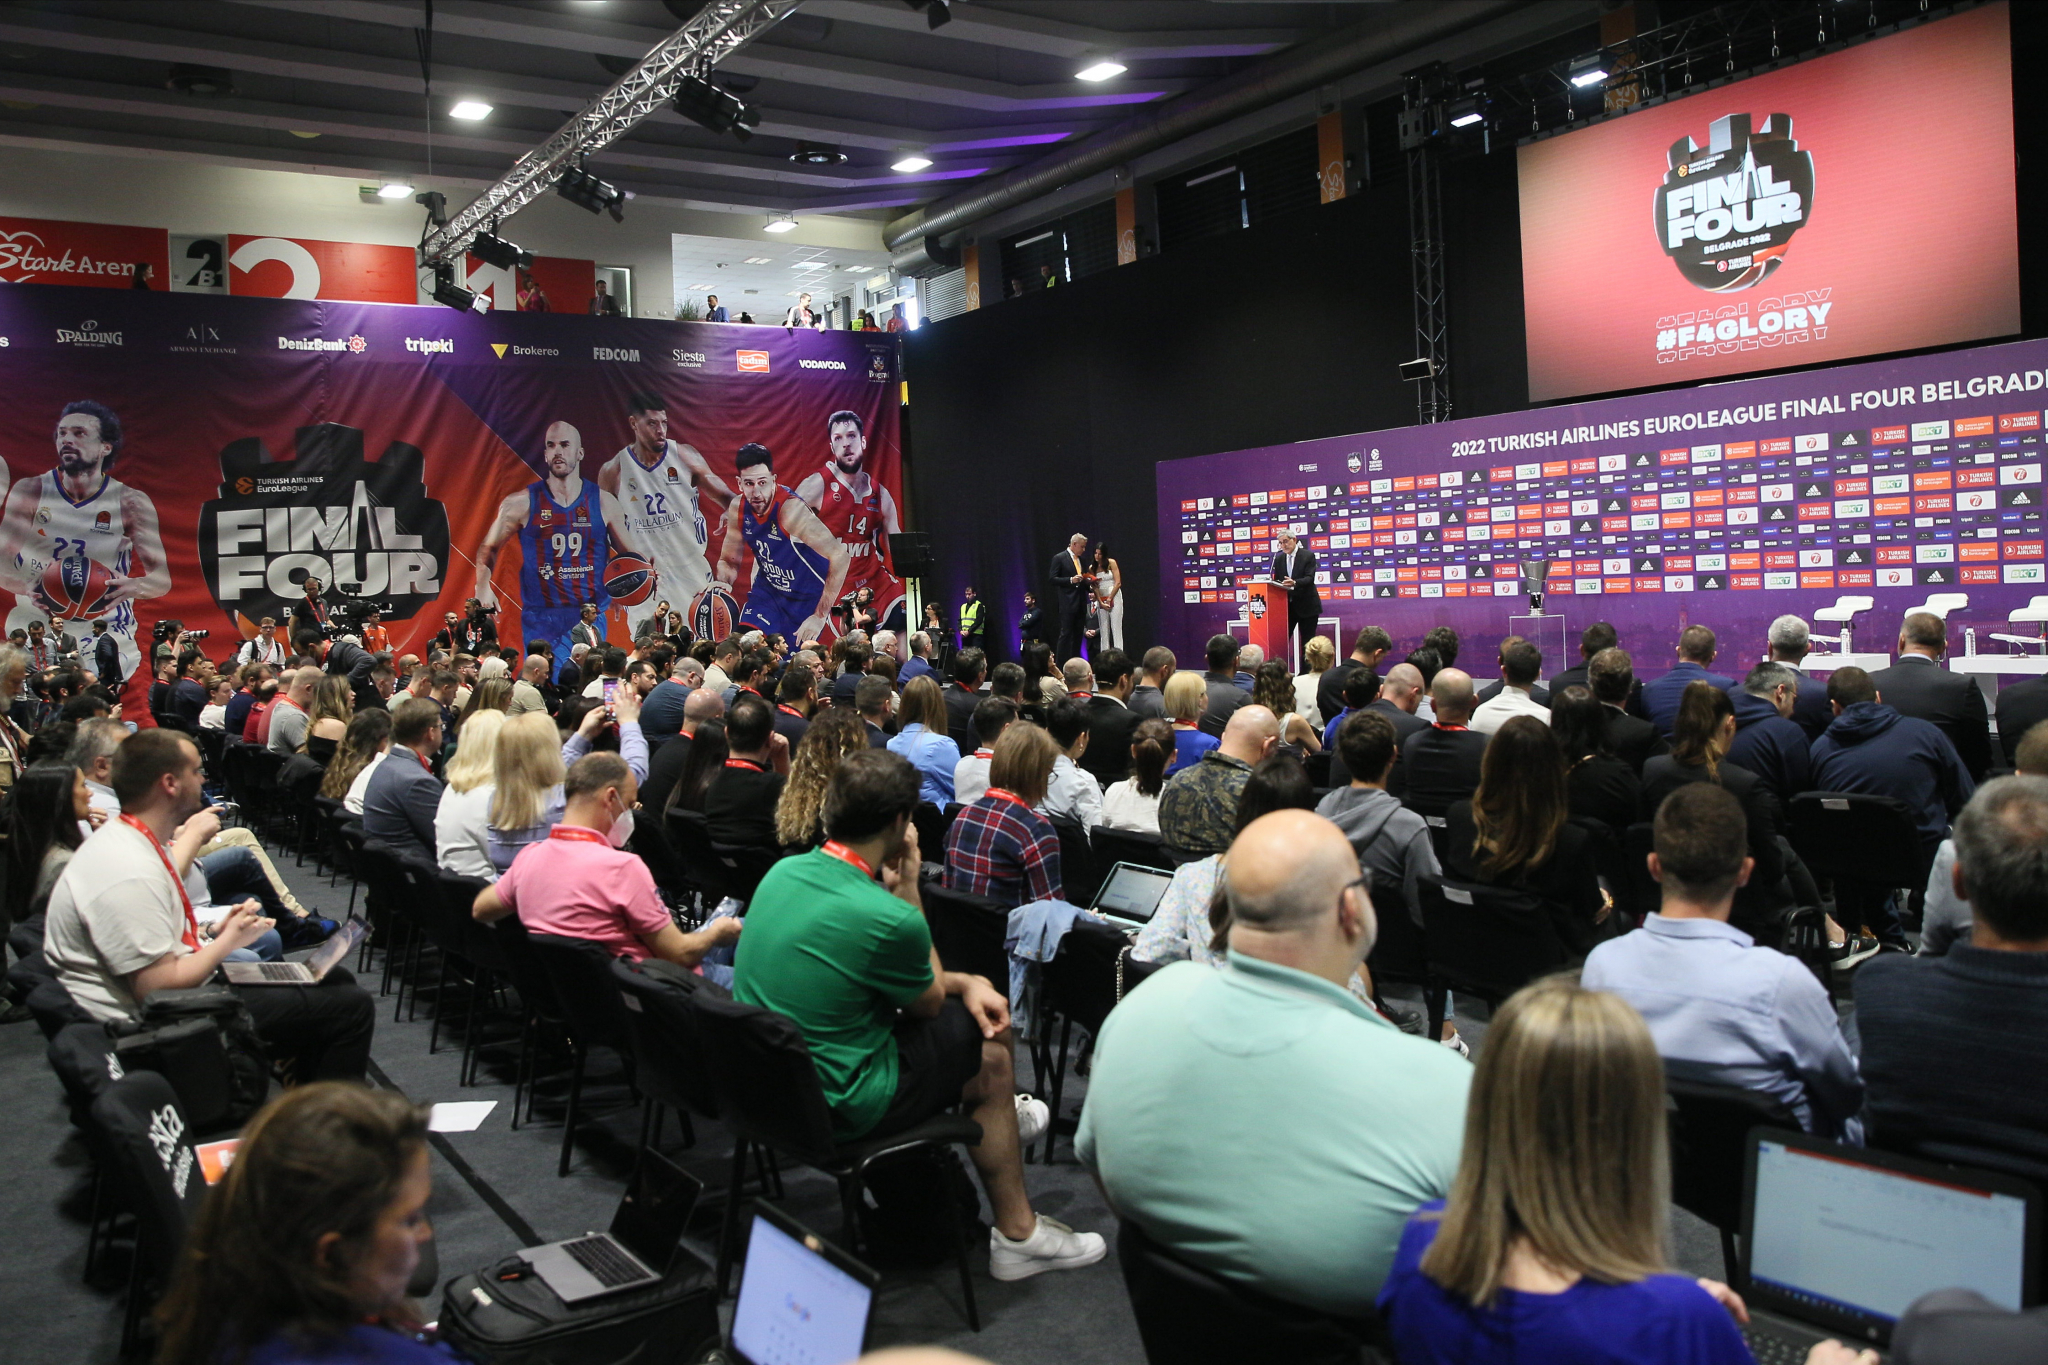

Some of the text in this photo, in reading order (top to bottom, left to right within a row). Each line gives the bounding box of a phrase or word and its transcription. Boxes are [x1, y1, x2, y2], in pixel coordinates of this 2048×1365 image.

[1666, 137, 1791, 220] FINAL
[1668, 192, 1802, 249] FOUR
[1704, 233, 1771, 254] BELGRADE 2022
[0, 243, 154, 278] Stark Aren
[1728, 256, 1752, 265] TURKISH
[1728, 260, 1752, 270] AIRLINES
[1656, 302, 1832, 350] #F4GLORY
[56, 328, 123, 346] SPALDING
[278, 336, 348, 352] DenizBank
[514, 346, 560, 356] Brokereo
[593, 347, 640, 362] FEDCOM
[672, 348, 706, 362] Siesta
[799, 360, 846, 370] VODAVODA
[1452, 370, 2048, 458] 2022 TURKISH AIRLINES EUROLEAGUE FINAL FOUR BELGRAD
[257, 484, 308, 494] EuroLeague
[644, 492, 666, 516] 22
[216, 480, 423, 555] FINAL
[634, 512, 683, 528] PALLADIUM
[848, 514, 866, 535] 14
[552, 532, 582, 558] 99
[1923, 549, 1947, 558] BKT
[218, 552, 440, 600] FOUR
[2011, 569, 2037, 578] BKT
